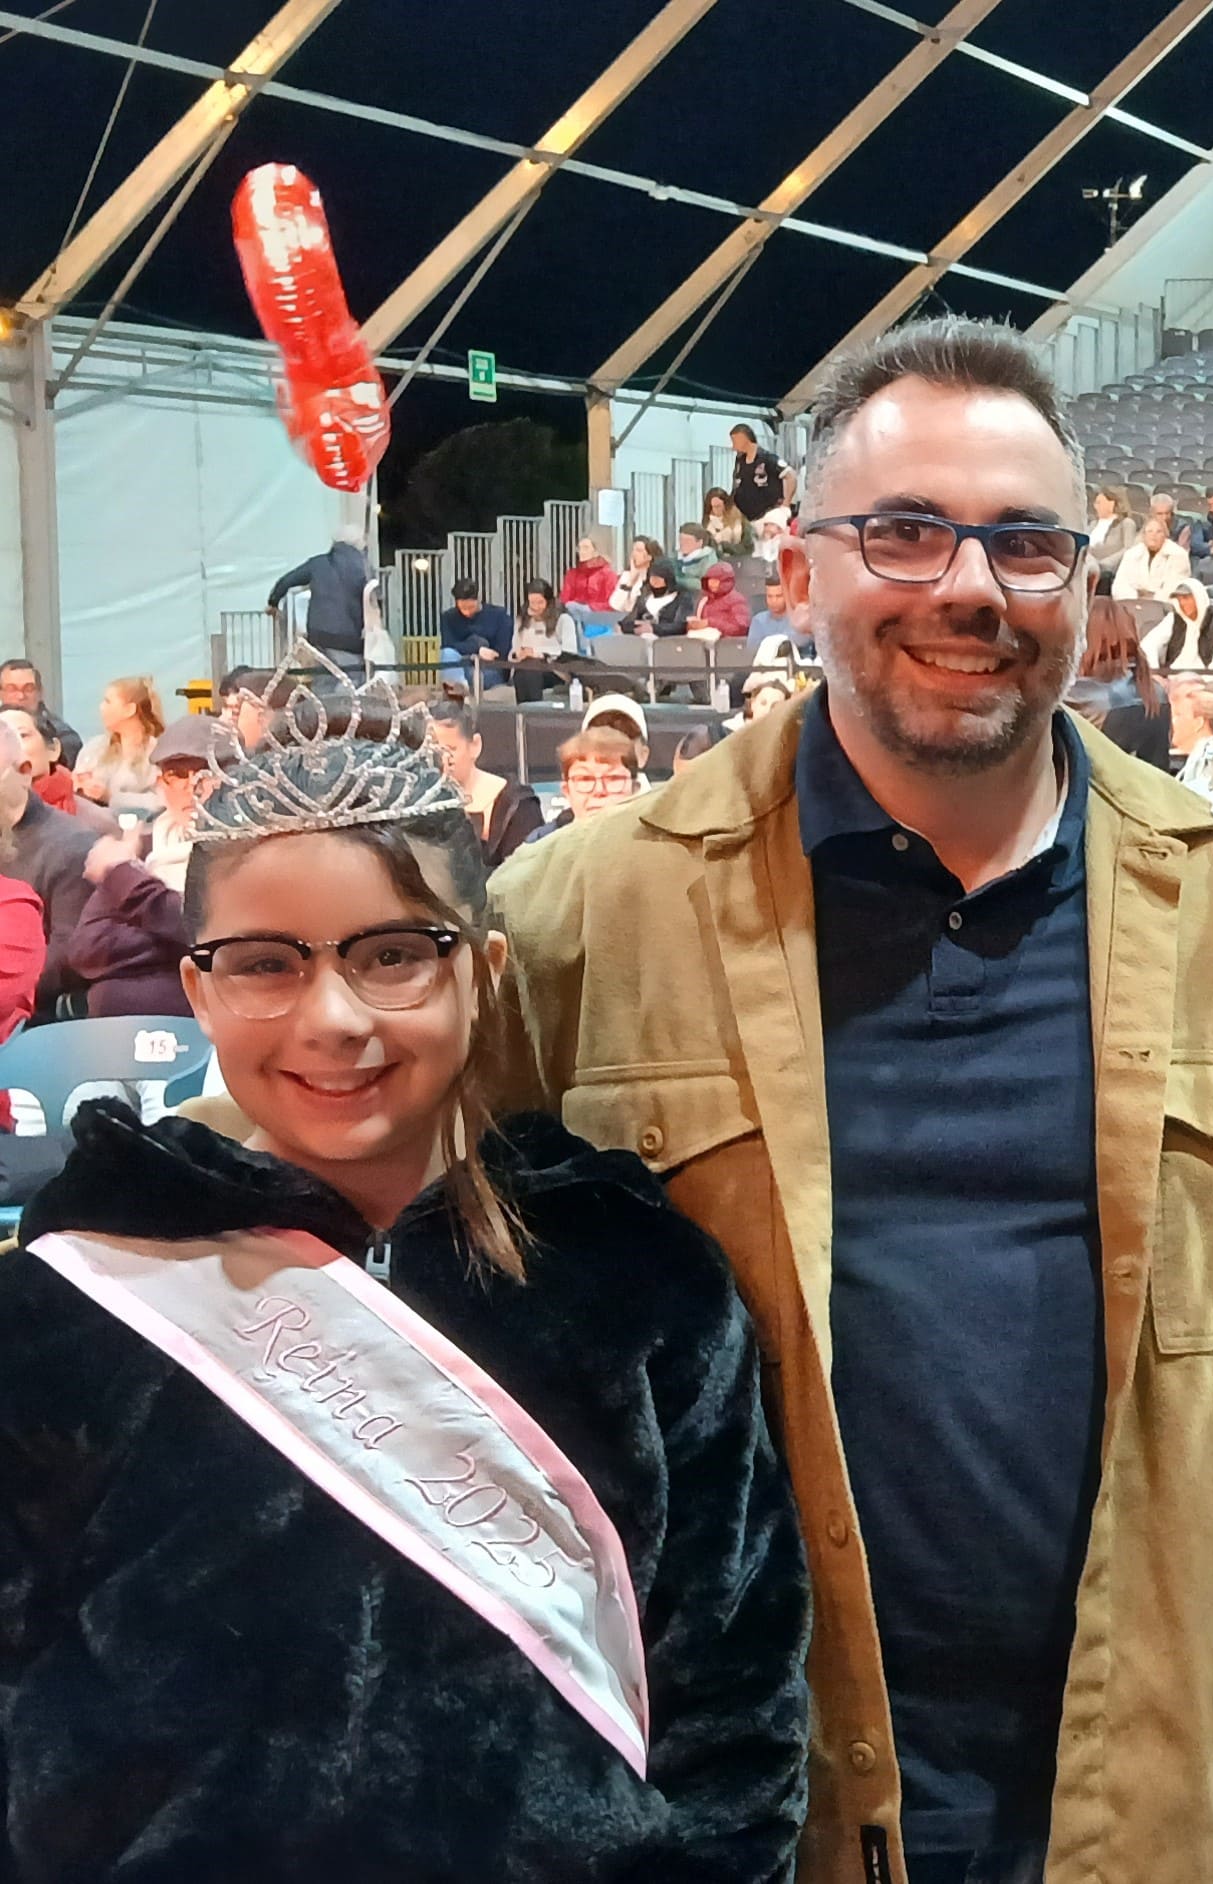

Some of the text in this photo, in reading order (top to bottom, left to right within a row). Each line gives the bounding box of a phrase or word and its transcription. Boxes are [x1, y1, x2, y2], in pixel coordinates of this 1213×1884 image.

[150, 1039, 167, 1054] 15
[232, 1295, 595, 1588] Reina 2025
